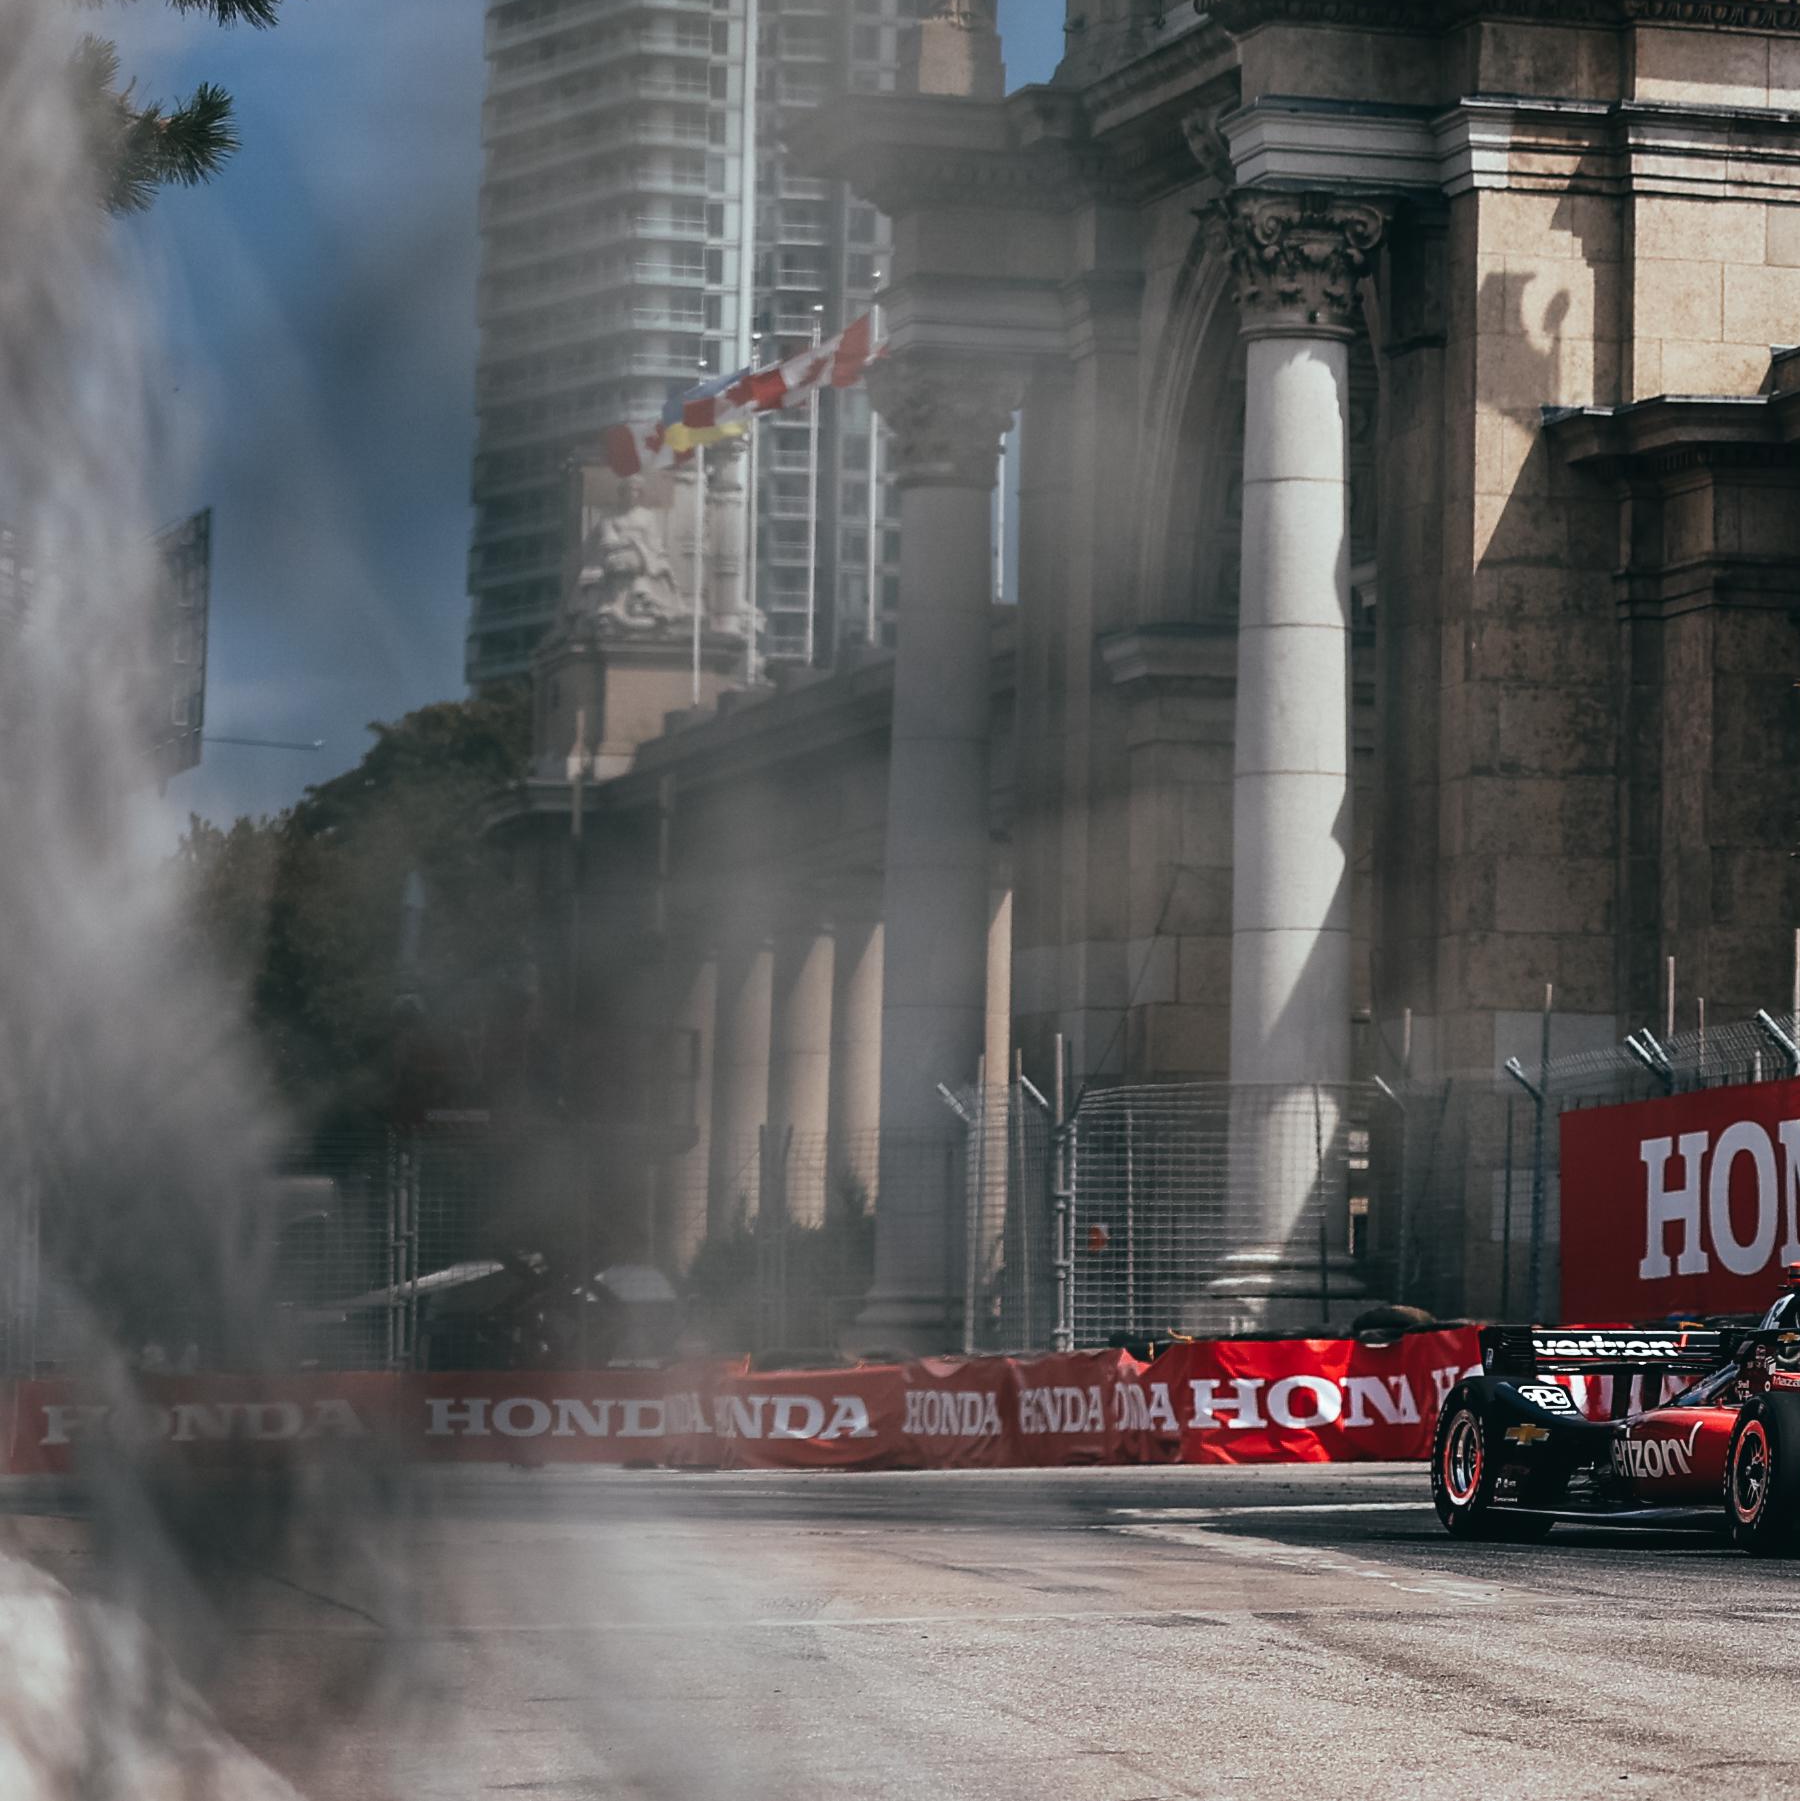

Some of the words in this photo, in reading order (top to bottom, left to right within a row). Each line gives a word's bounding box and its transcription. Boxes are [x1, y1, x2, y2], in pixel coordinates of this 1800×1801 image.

[1532, 1335, 1679, 1357] verizon
[902, 1391, 1002, 1436] HONDA
[1188, 1374, 1421, 1429] HON
[1611, 1427, 1693, 1479] erizon
